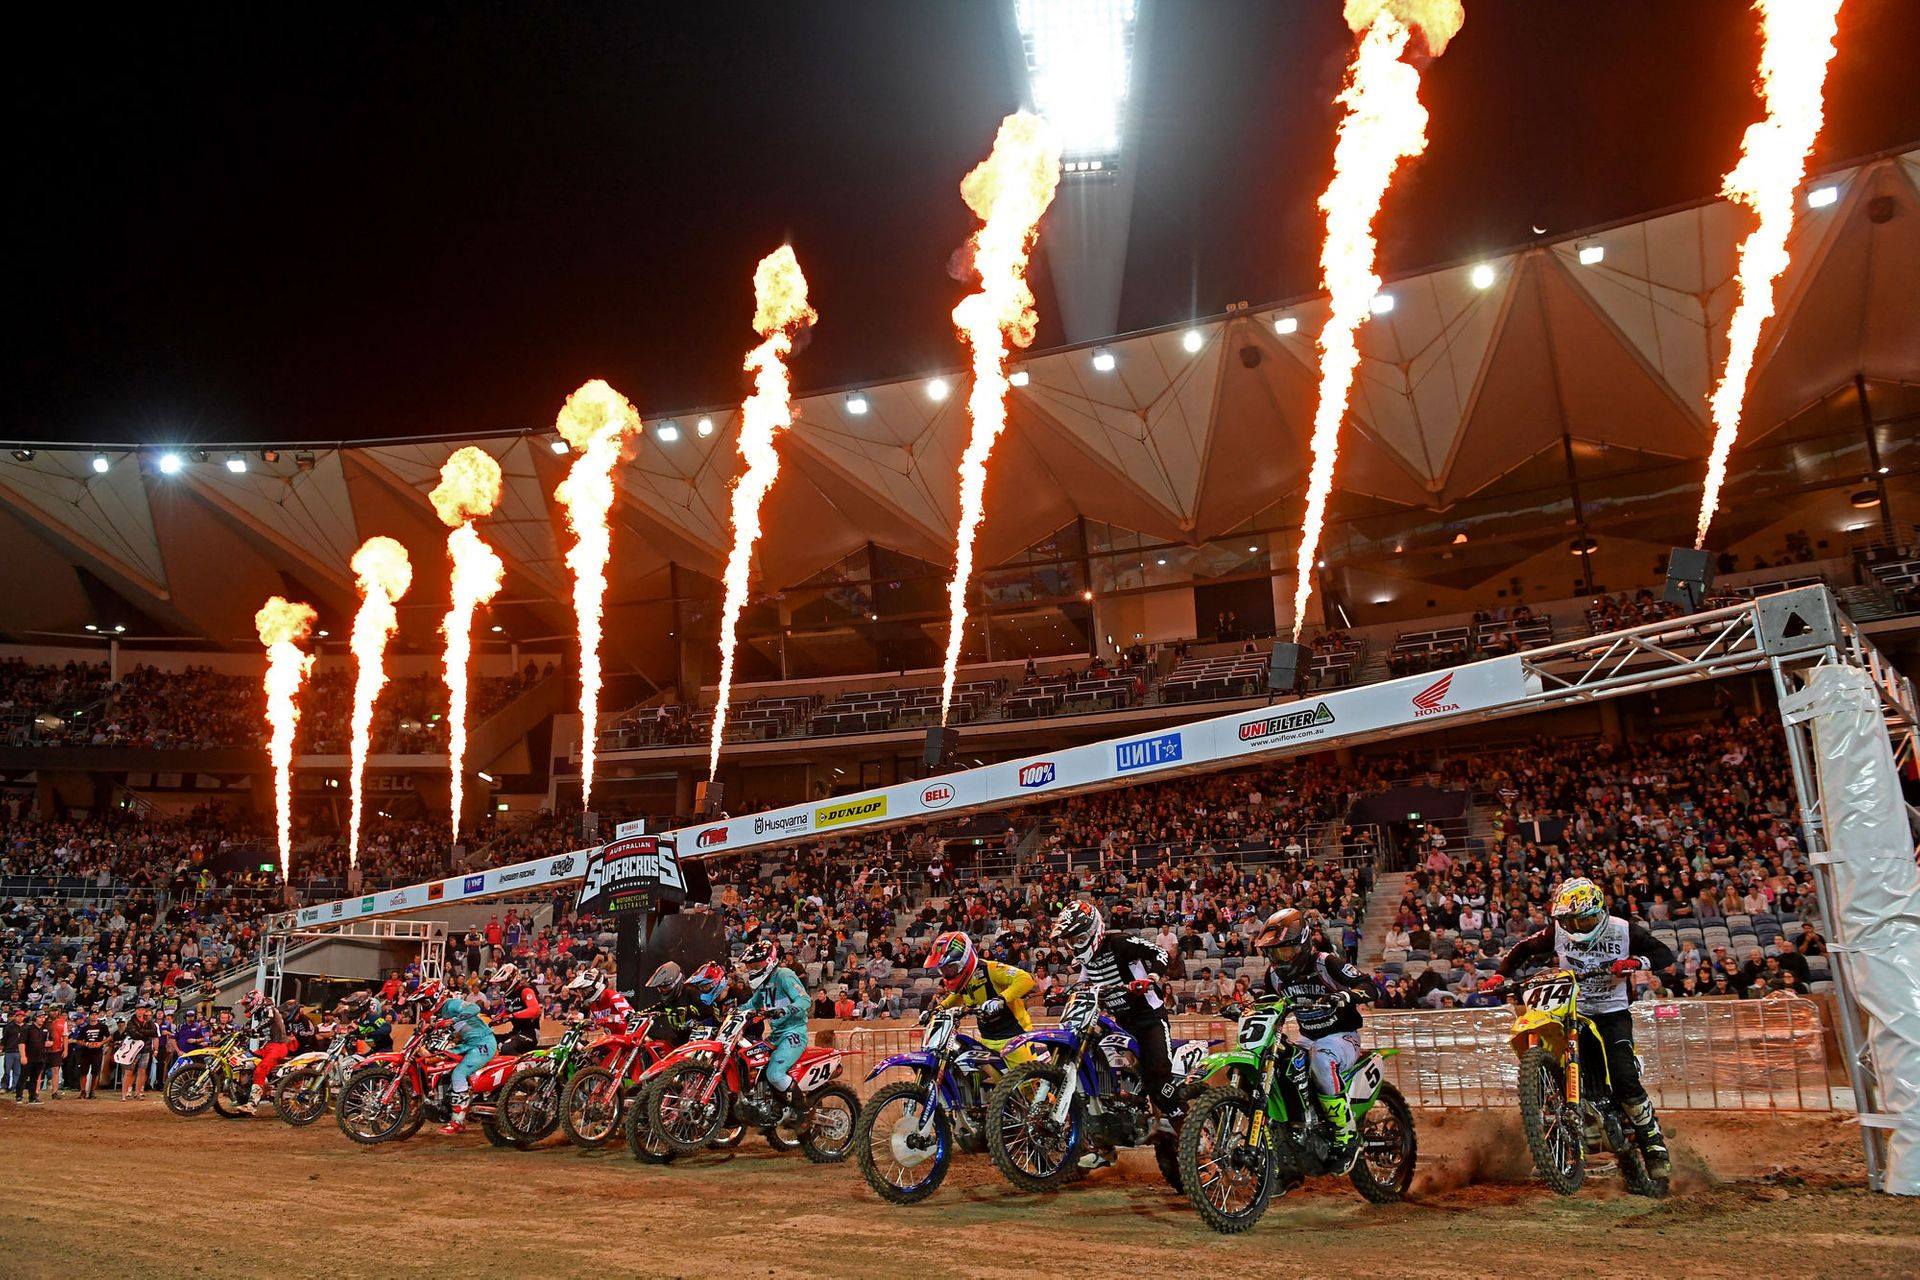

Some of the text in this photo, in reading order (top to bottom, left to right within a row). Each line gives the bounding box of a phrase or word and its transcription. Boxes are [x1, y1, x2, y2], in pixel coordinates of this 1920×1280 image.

[1414, 703, 1459, 717] HONDA
[1250, 729, 1324, 747] www.uniflow.com.au
[1119, 741, 1161, 769] UNIT
[1022, 764, 1053, 786] 100%
[925, 788, 950, 802] BELL
[828, 802, 882, 820] DUNLOP
[764, 814, 808, 831] Husqvarna
[609, 842, 651, 855] AUSTRALIAN
[580, 847, 683, 904] SUPERCROSS
[609, 881, 651, 892] CHAMPIONSHIP
[1527, 983, 1573, 1009] 414
[1239, 1017, 1268, 1043] 5
[491, 1068, 505, 1087] 1
[808, 1062, 831, 1087] 24
[1364, 1063, 1381, 1089] 5
[923, 1089, 936, 1121] DUNLOP
